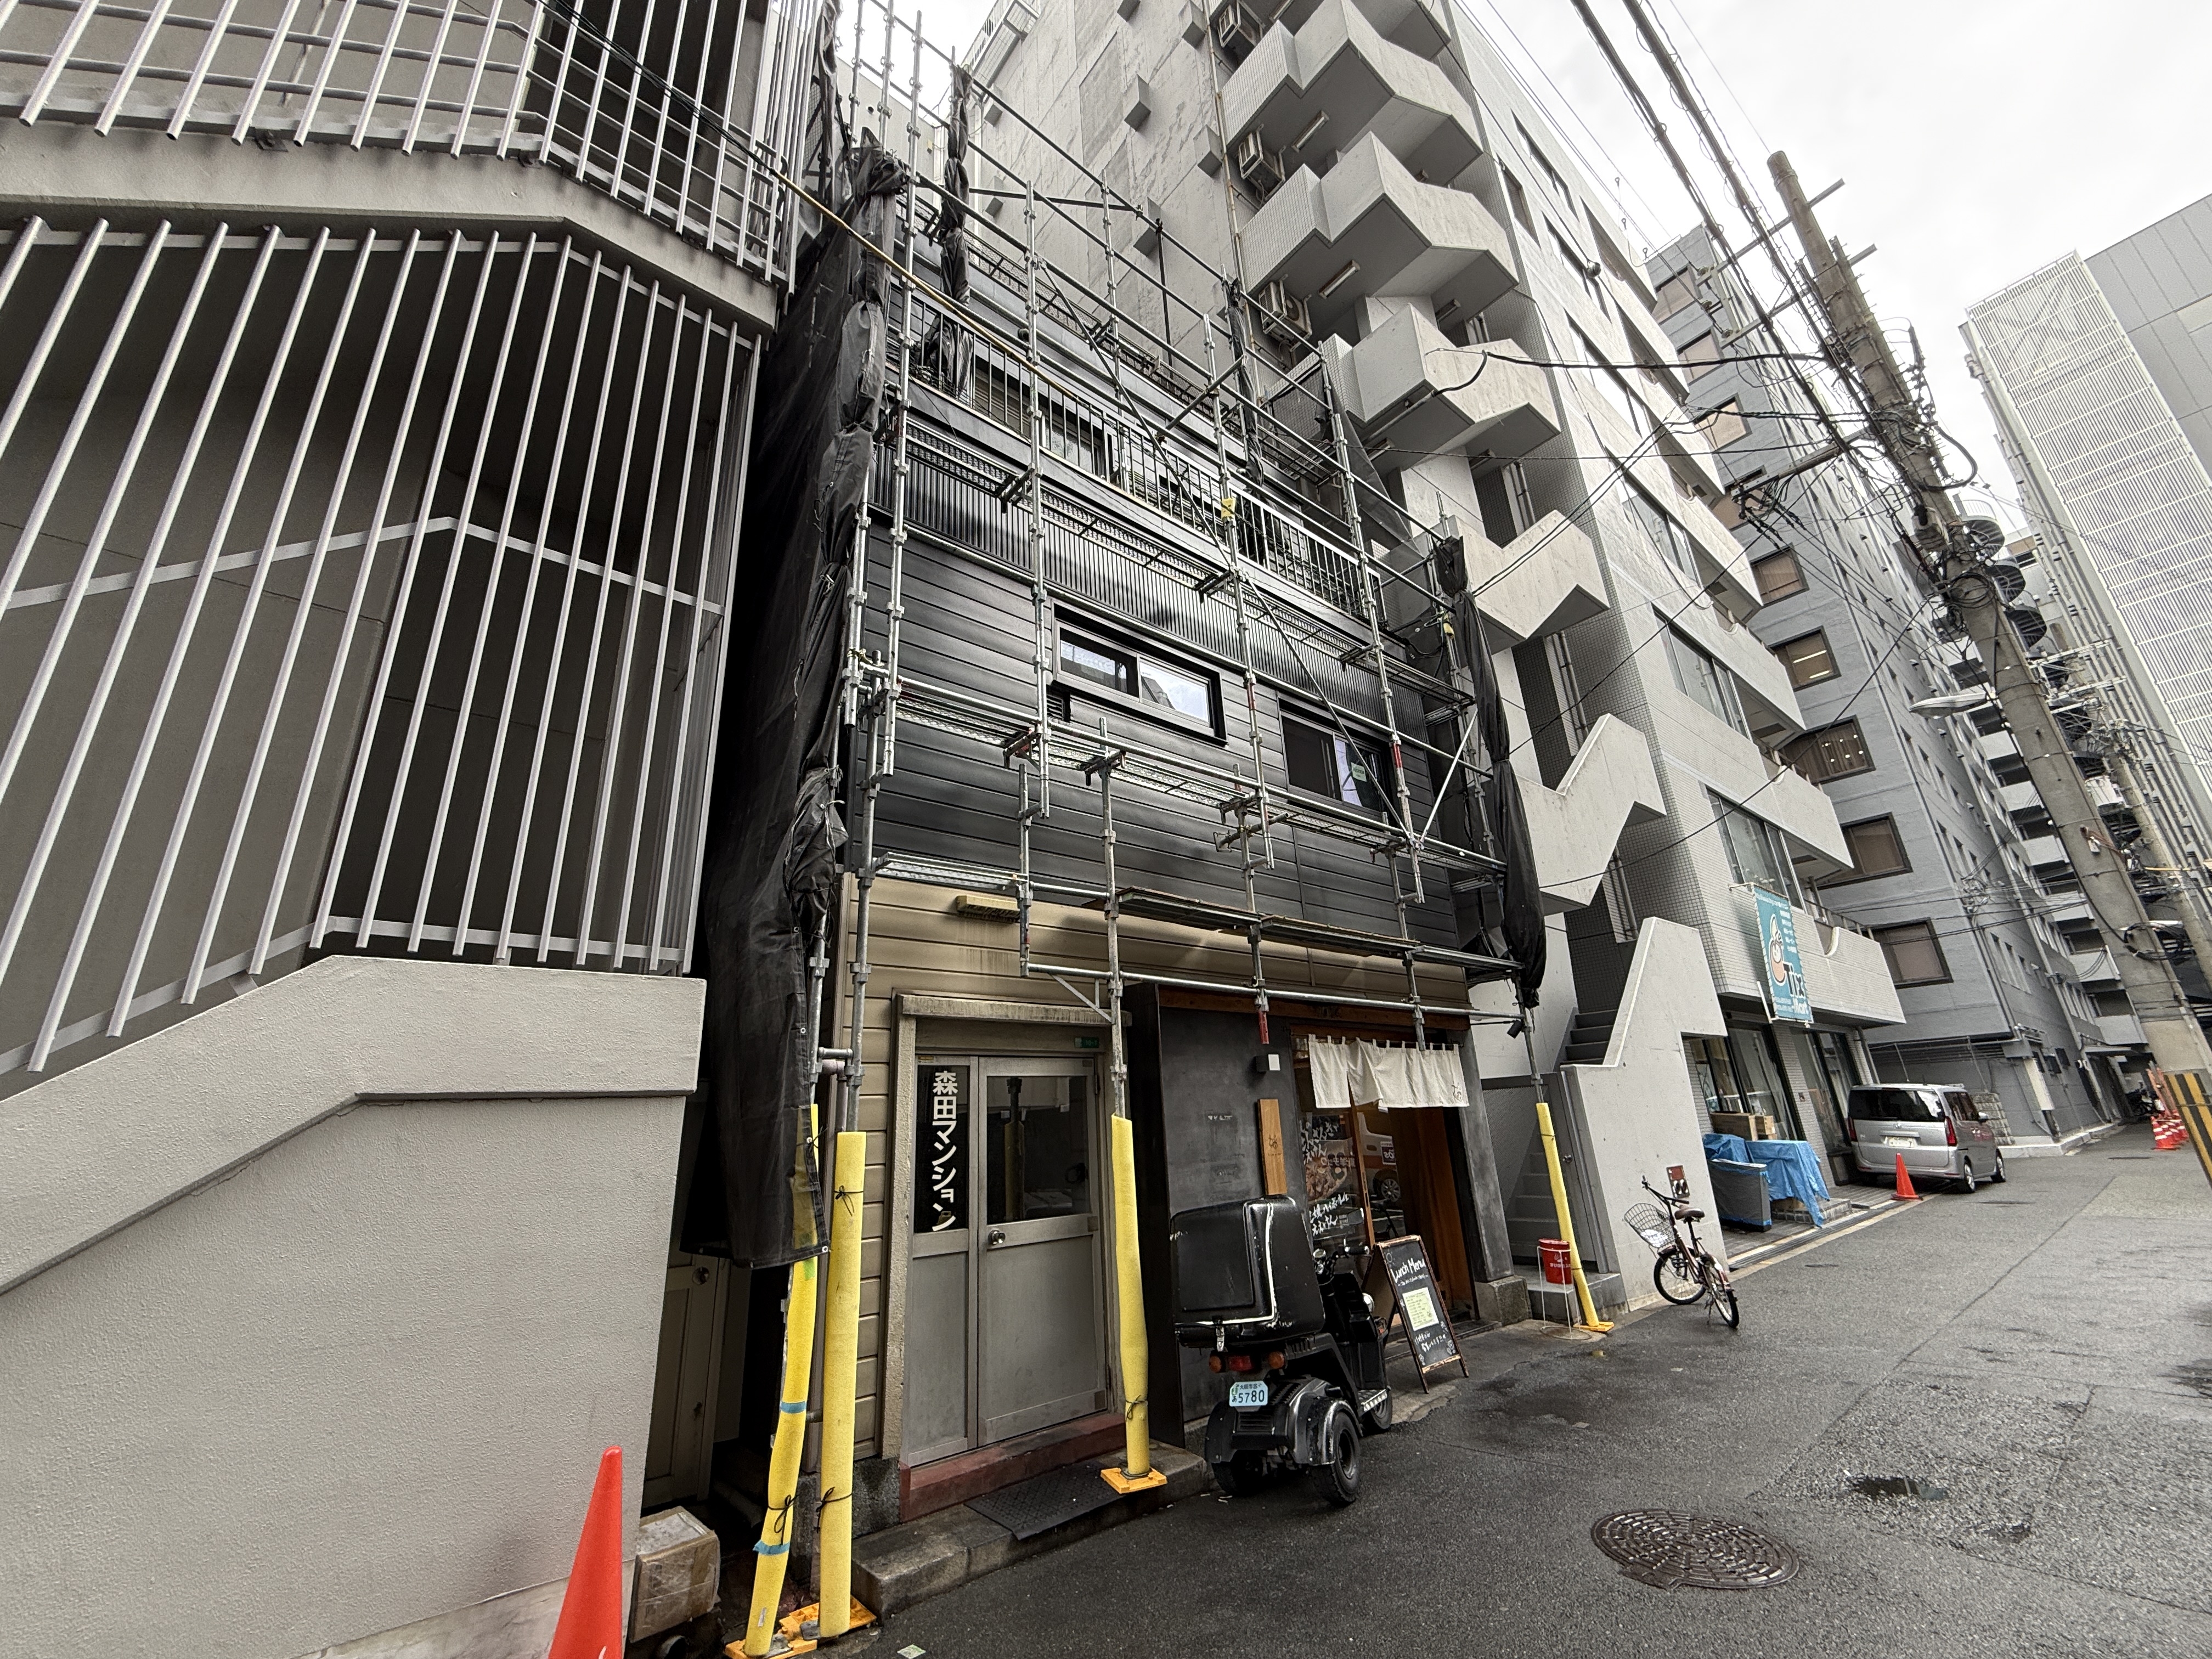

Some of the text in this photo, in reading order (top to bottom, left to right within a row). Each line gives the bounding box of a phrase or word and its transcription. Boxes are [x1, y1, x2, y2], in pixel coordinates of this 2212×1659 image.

[1783, 963, 1805, 998] Tix
[932, 1070, 958, 1232] 森田マンション
[1390, 1261, 1410, 1283] Lunch
[1408, 1257, 1426, 1274] Menu
[1238, 1390, 1265, 1403] 5780
